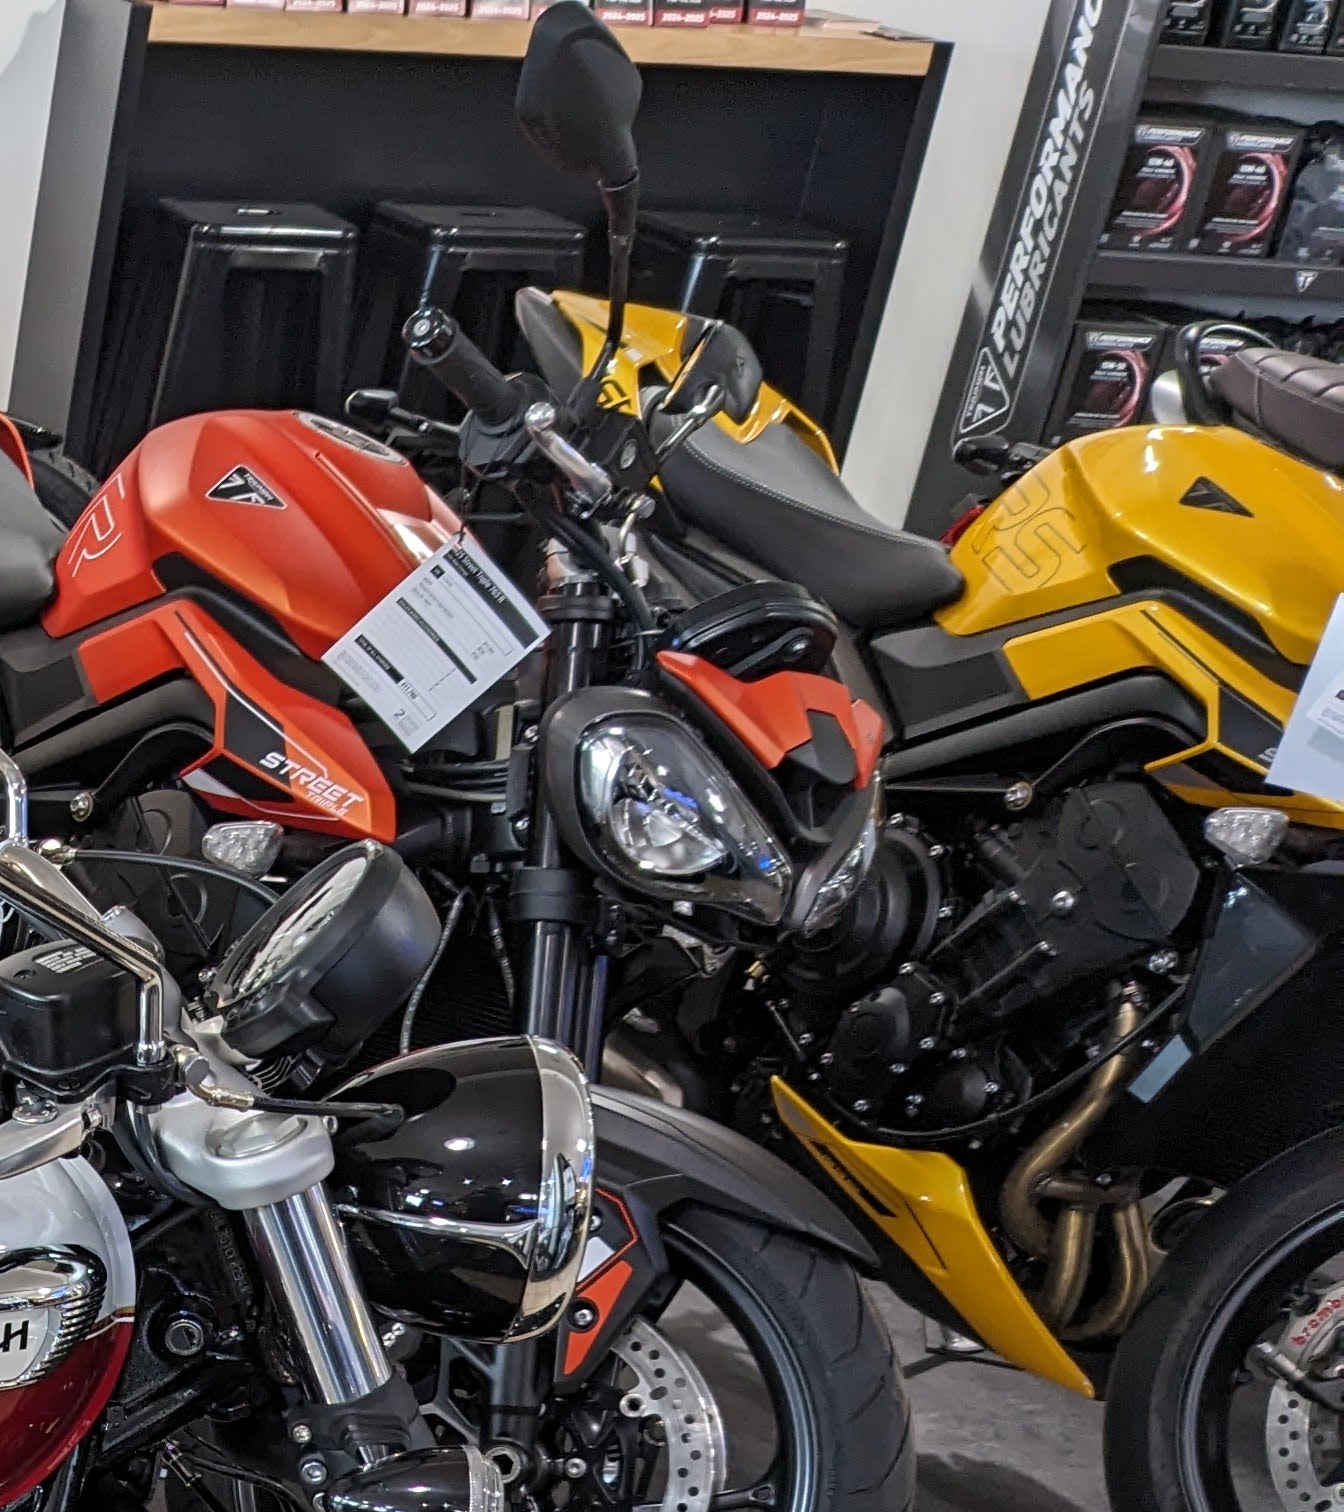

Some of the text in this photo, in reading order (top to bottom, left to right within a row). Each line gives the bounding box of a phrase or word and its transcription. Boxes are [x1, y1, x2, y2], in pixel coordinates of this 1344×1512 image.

[662, 12, 704, 22] 2024-2025
[756, 11, 799, 21] 2024-2025
[991, 0, 1103, 354] PERFORMANC
[1004, 79, 1095, 378] LUBRICANTS
[461, 554, 479, 574] Street
[473, 569, 493, 590] Triple
[392, 706, 407, 721] 2
[258, 751, 365, 808] STREET
[306, 791, 349, 818] TRIPLE
